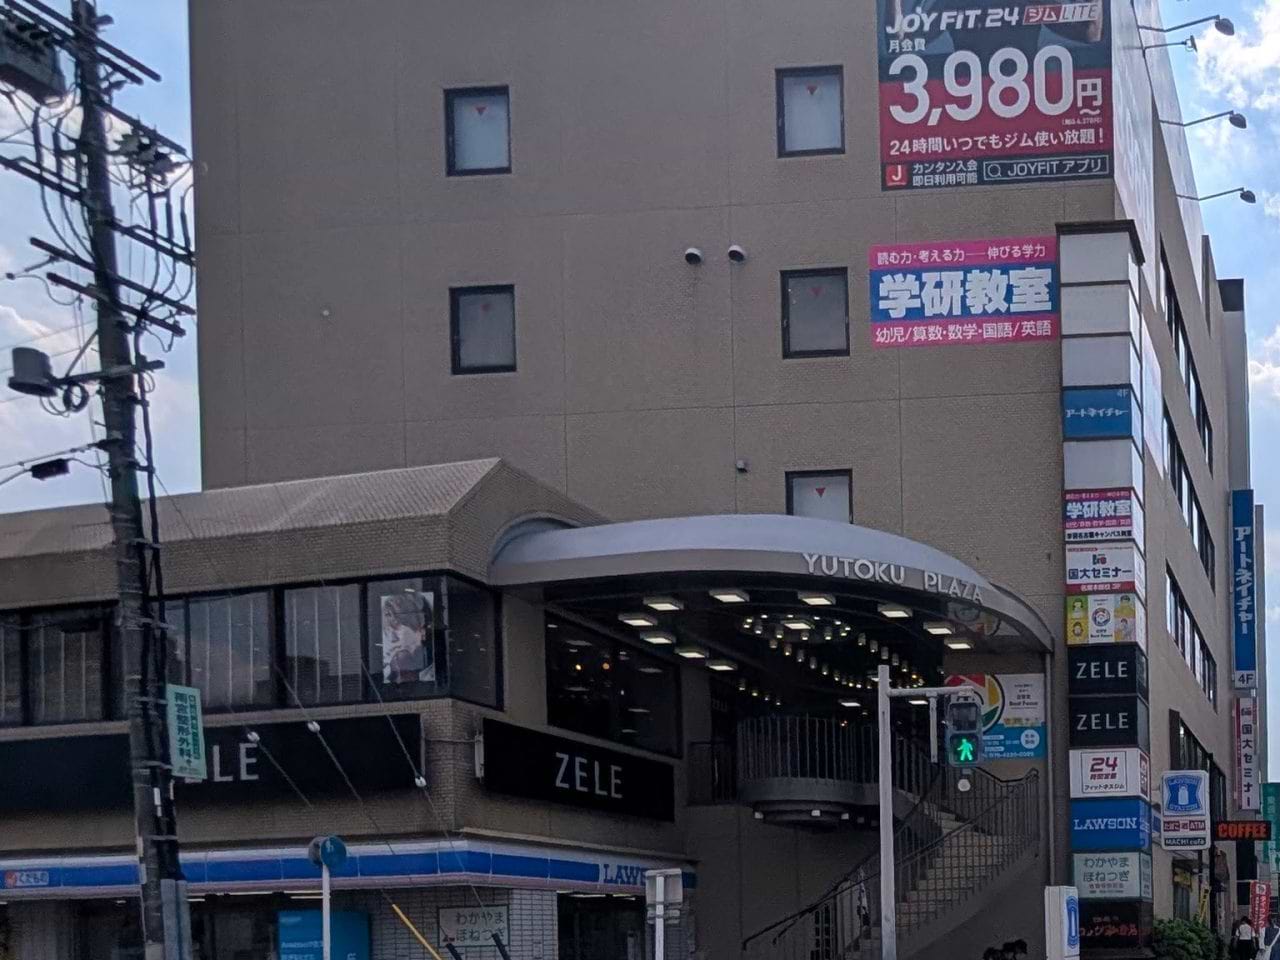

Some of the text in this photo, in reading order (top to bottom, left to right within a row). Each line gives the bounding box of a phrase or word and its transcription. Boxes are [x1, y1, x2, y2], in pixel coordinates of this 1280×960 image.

[913, 159, 978, 174] カンタン入会
[912, 172, 978, 187] 即日利用可能
[878, 266, 1052, 319] 学研教室
[1066, 499, 1132, 519] 学研教室
[803, 553, 983, 603] YUTOKU PLAZA
[1068, 566, 1133, 580] 国大セミナー
[1233, 525, 1253, 635] アートネイチャー
[1075, 661, 1129, 679] ZELE
[1237, 673, 1254, 685] 4F
[1076, 711, 1129, 732] ZELE
[1090, 757, 1119, 773] 24
[554, 751, 624, 800] ZELE
[1073, 817, 1138, 831] LAWSON
[1217, 822, 1268, 839] COFFEE
[1083, 857, 1130, 869] わかやま
[1083, 870, 1130, 883] ほねつぎ
[456, 911, 505, 926] わかやま
